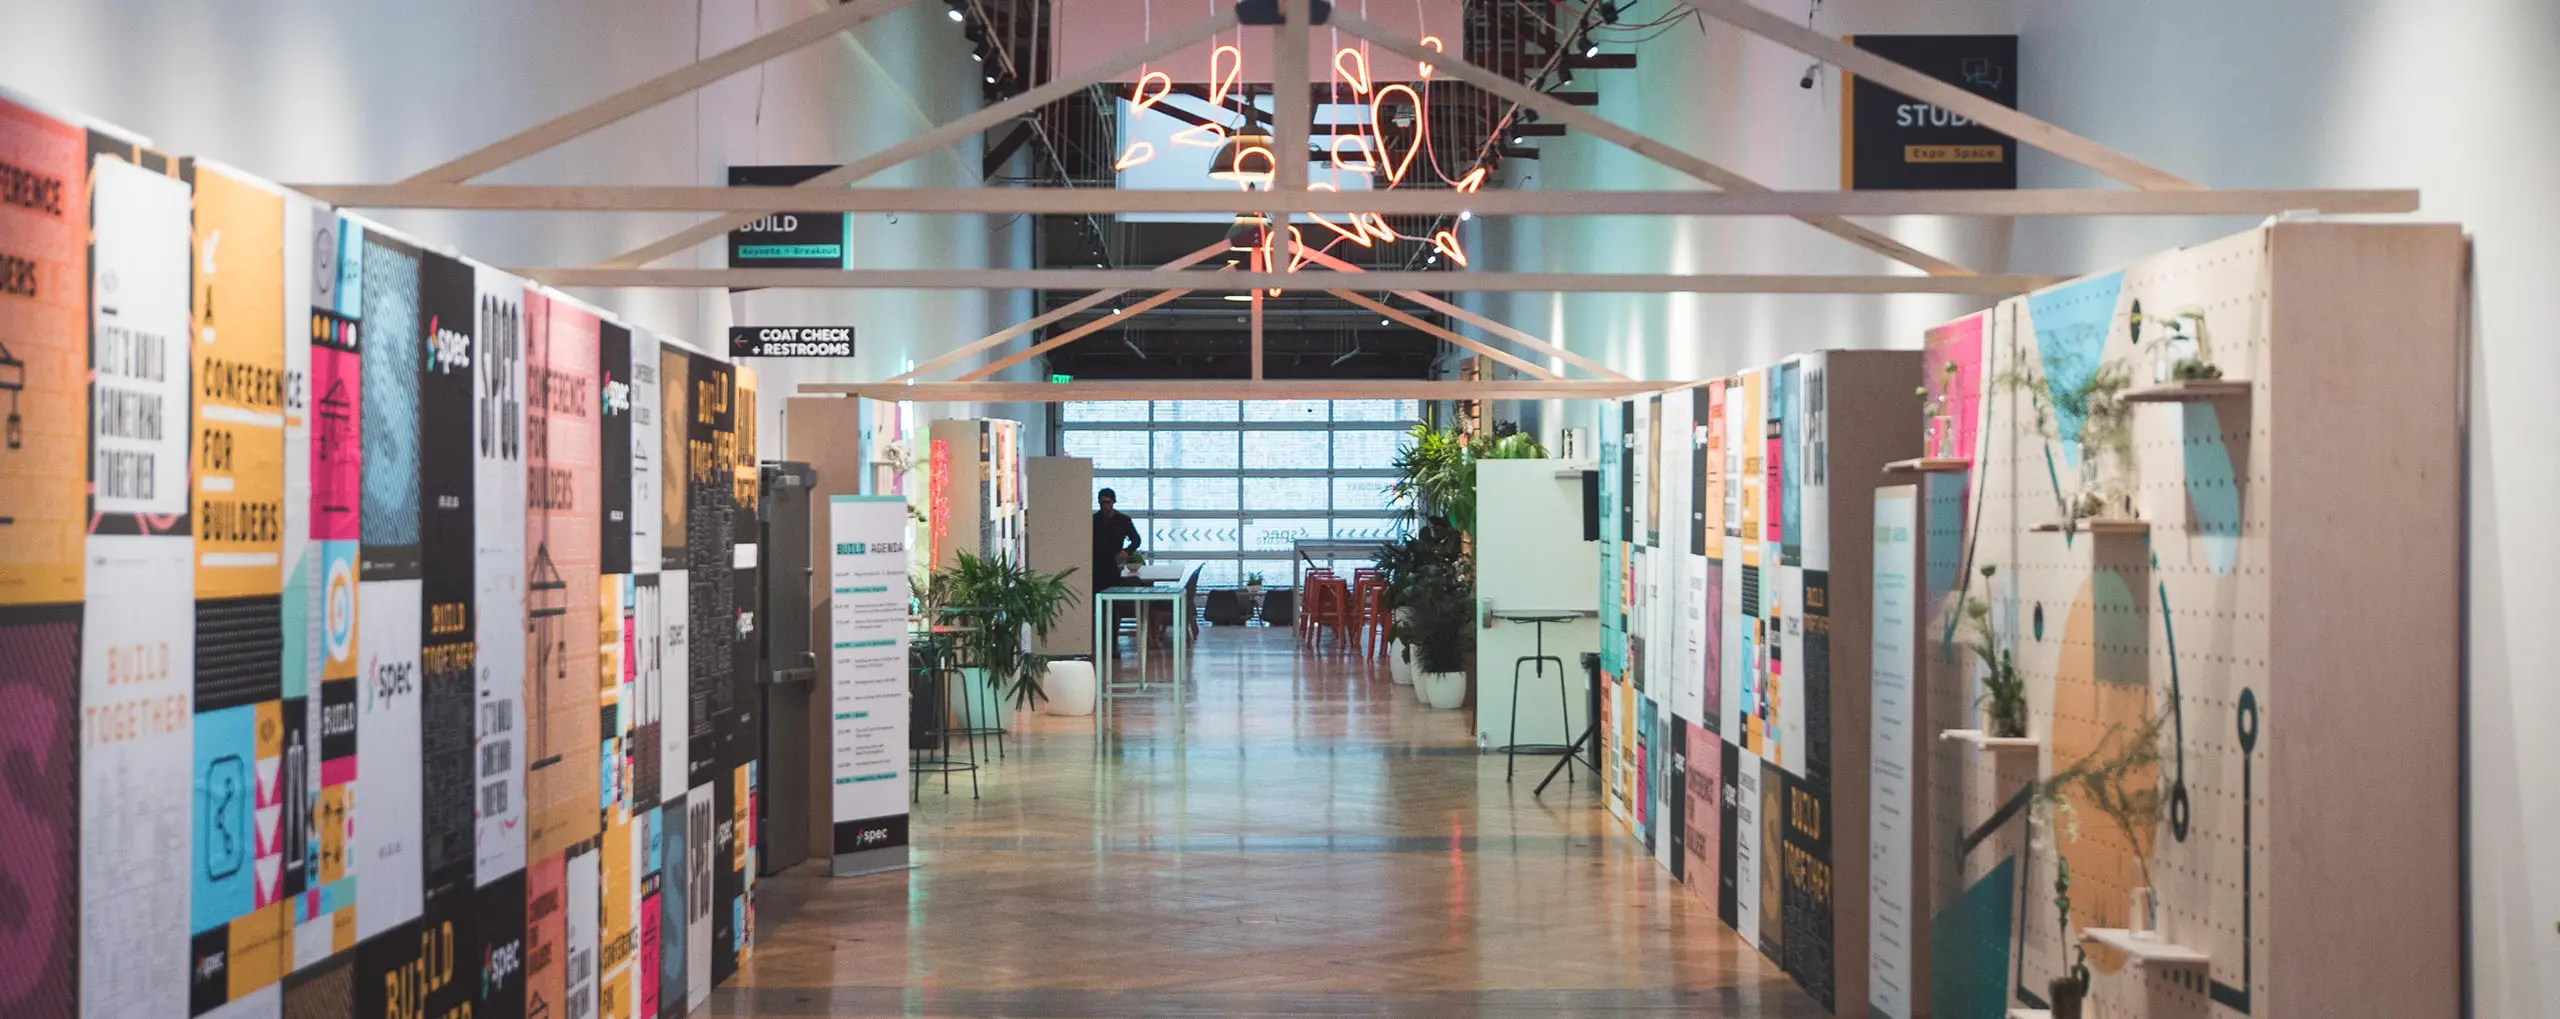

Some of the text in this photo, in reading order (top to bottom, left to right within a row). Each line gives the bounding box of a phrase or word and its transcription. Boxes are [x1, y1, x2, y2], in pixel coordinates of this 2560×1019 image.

[1896, 104, 1979, 127] STUD
[1912, 147, 1996, 159] Expo Space
[793, 246, 838, 255] Breakout
[759, 328, 850, 342] COAT CHECK
[763, 343, 850, 356] RESTROOMS
[203, 357, 302, 410] CONFERENCE
[202, 428, 233, 473] FOR
[202, 500, 279, 542] BUILDERS
[836, 542, 904, 555] BUILD AGENDA
[107, 641, 170, 686] BUILD
[379, 660, 412, 710] spec
[86, 693, 187, 750] TOGETHER
[864, 827, 888, 842] spec
[386, 920, 454, 1019] BUILD
[490, 938, 520, 991] spec
